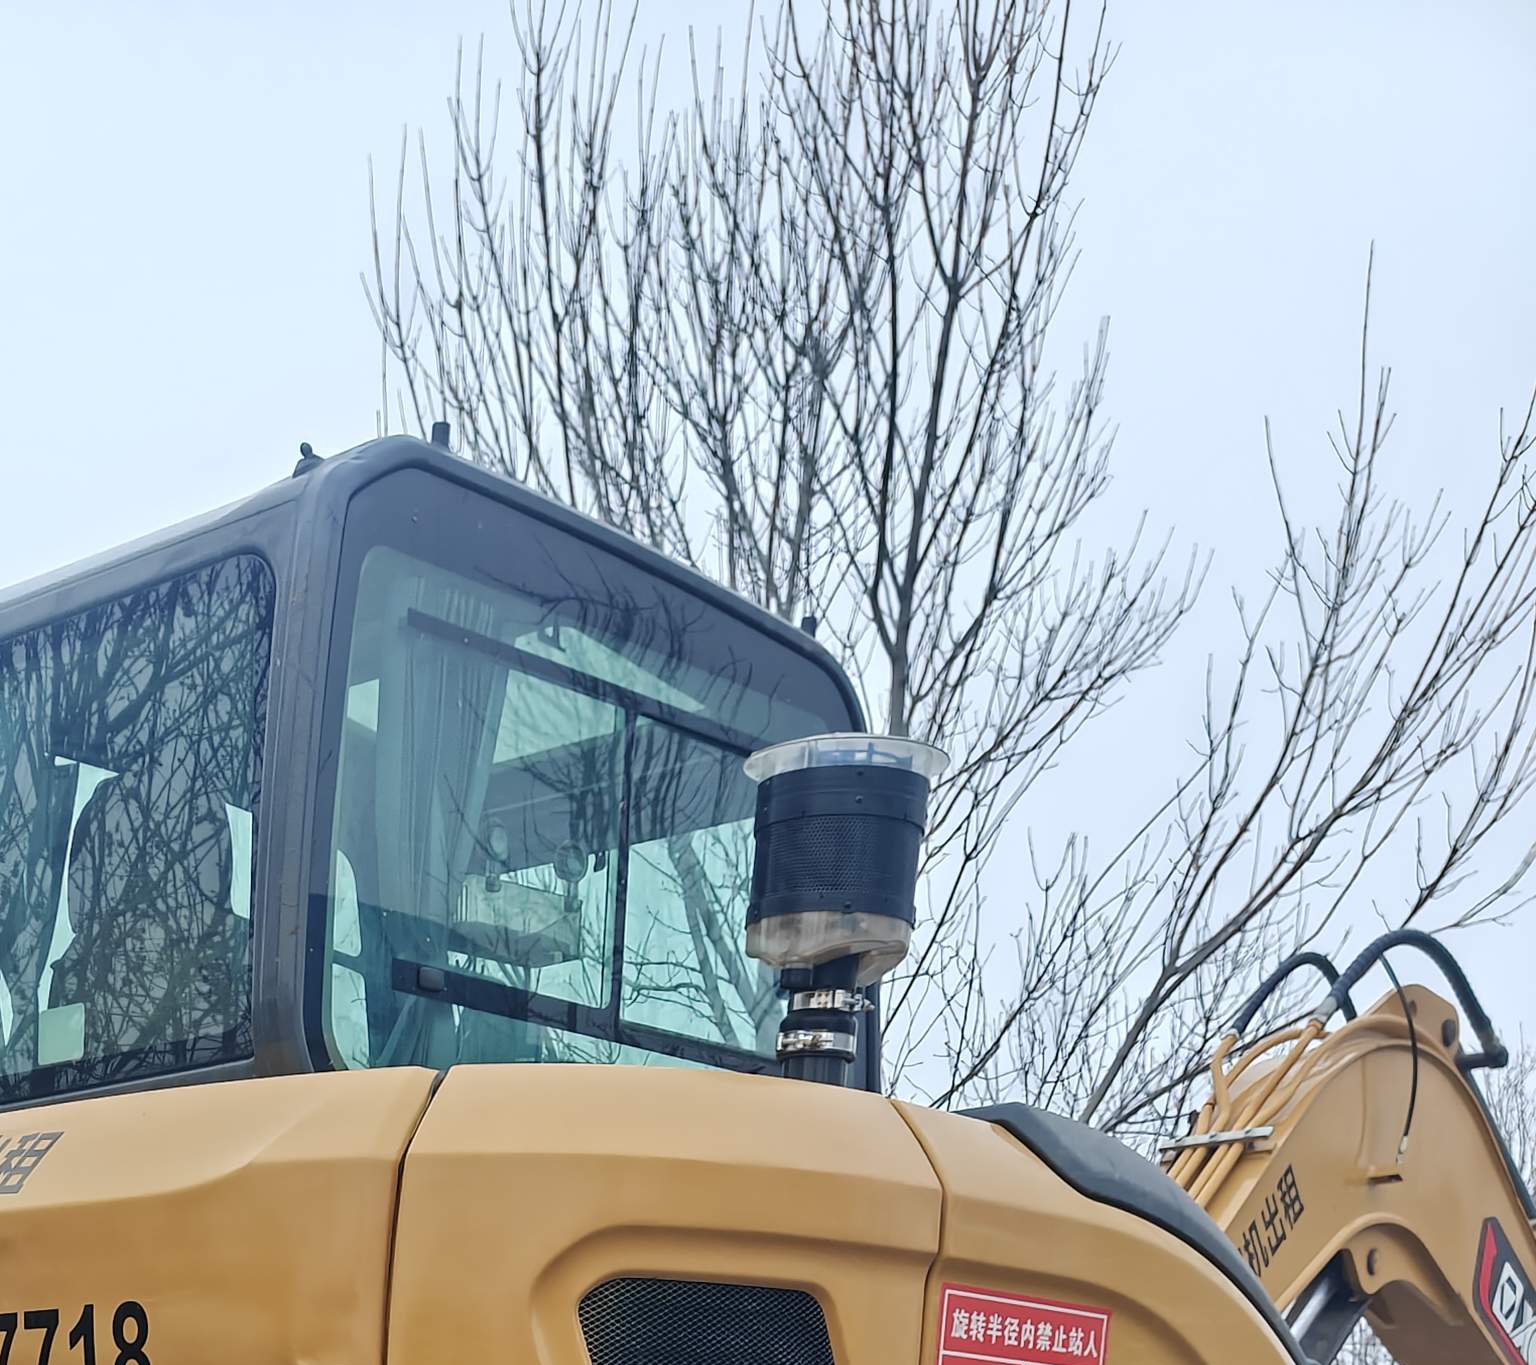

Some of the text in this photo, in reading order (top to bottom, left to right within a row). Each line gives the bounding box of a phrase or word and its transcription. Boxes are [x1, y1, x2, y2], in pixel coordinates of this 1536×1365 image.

[1238, 1164, 1304, 1278] 机出租
[951, 1309, 1099, 1359] 旋转半径内禁止站人
